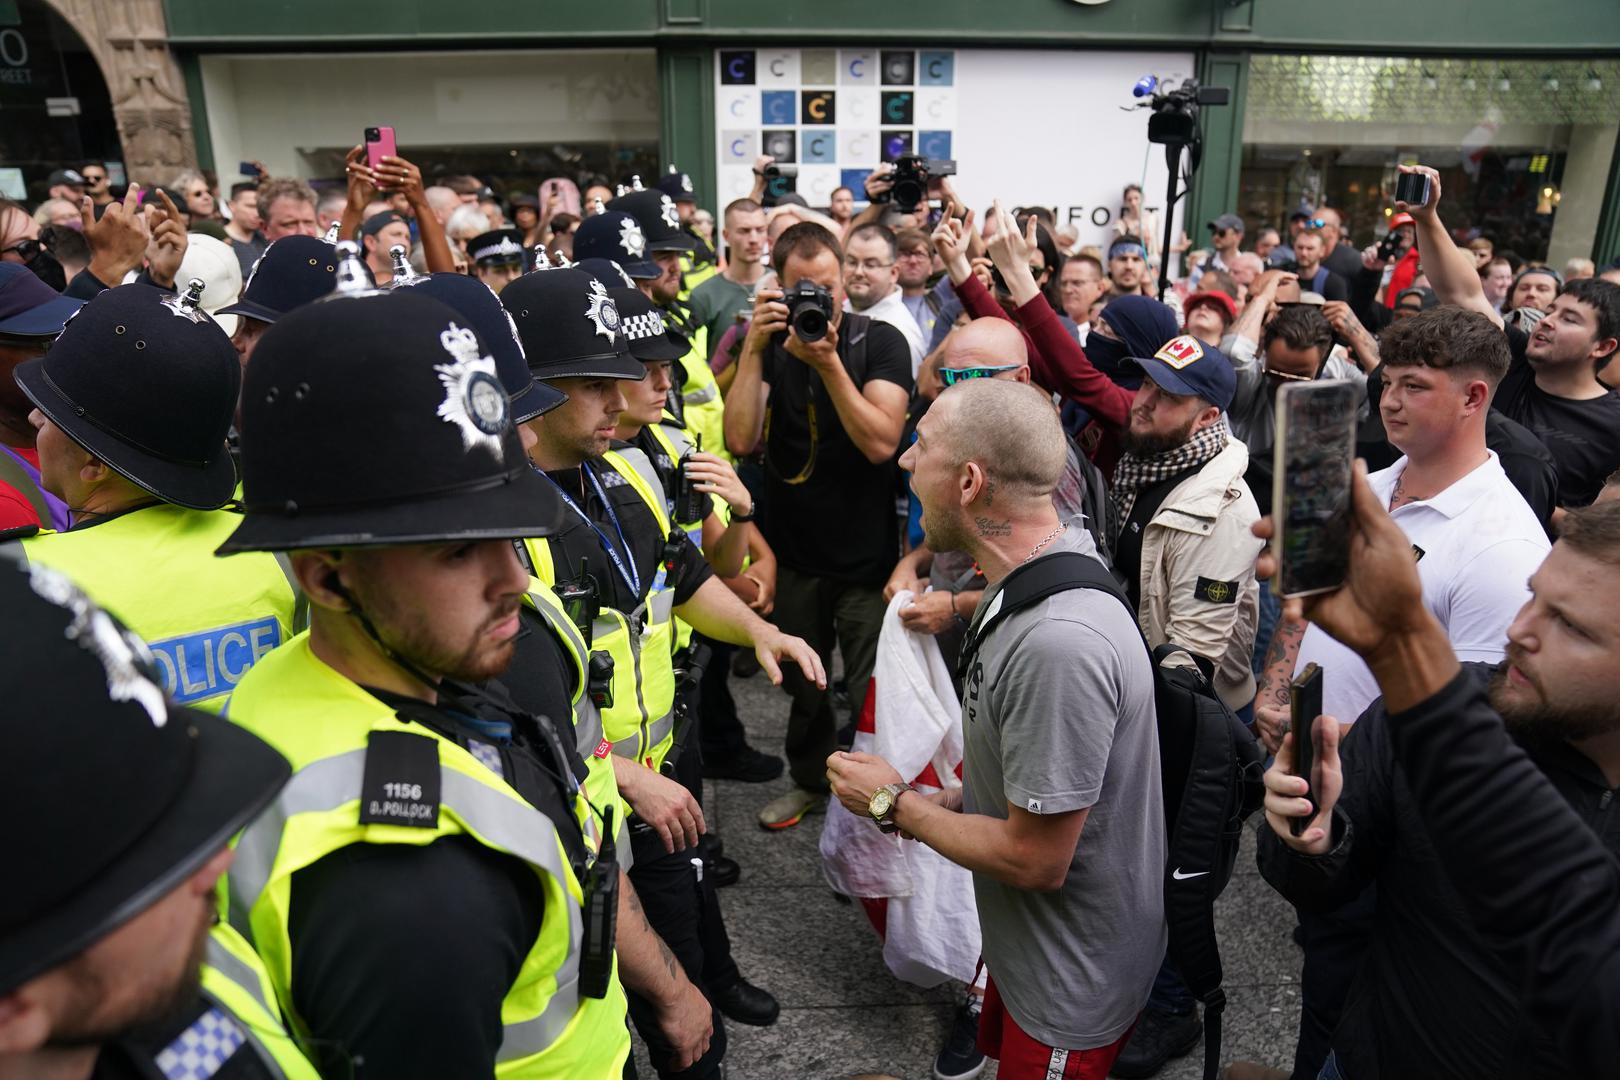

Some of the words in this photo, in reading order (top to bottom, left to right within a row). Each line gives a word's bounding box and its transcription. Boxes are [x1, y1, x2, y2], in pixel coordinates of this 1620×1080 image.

[808, 97, 826, 119] C
[150, 625, 274, 698] OLICE
[383, 783, 422, 800] 1156
